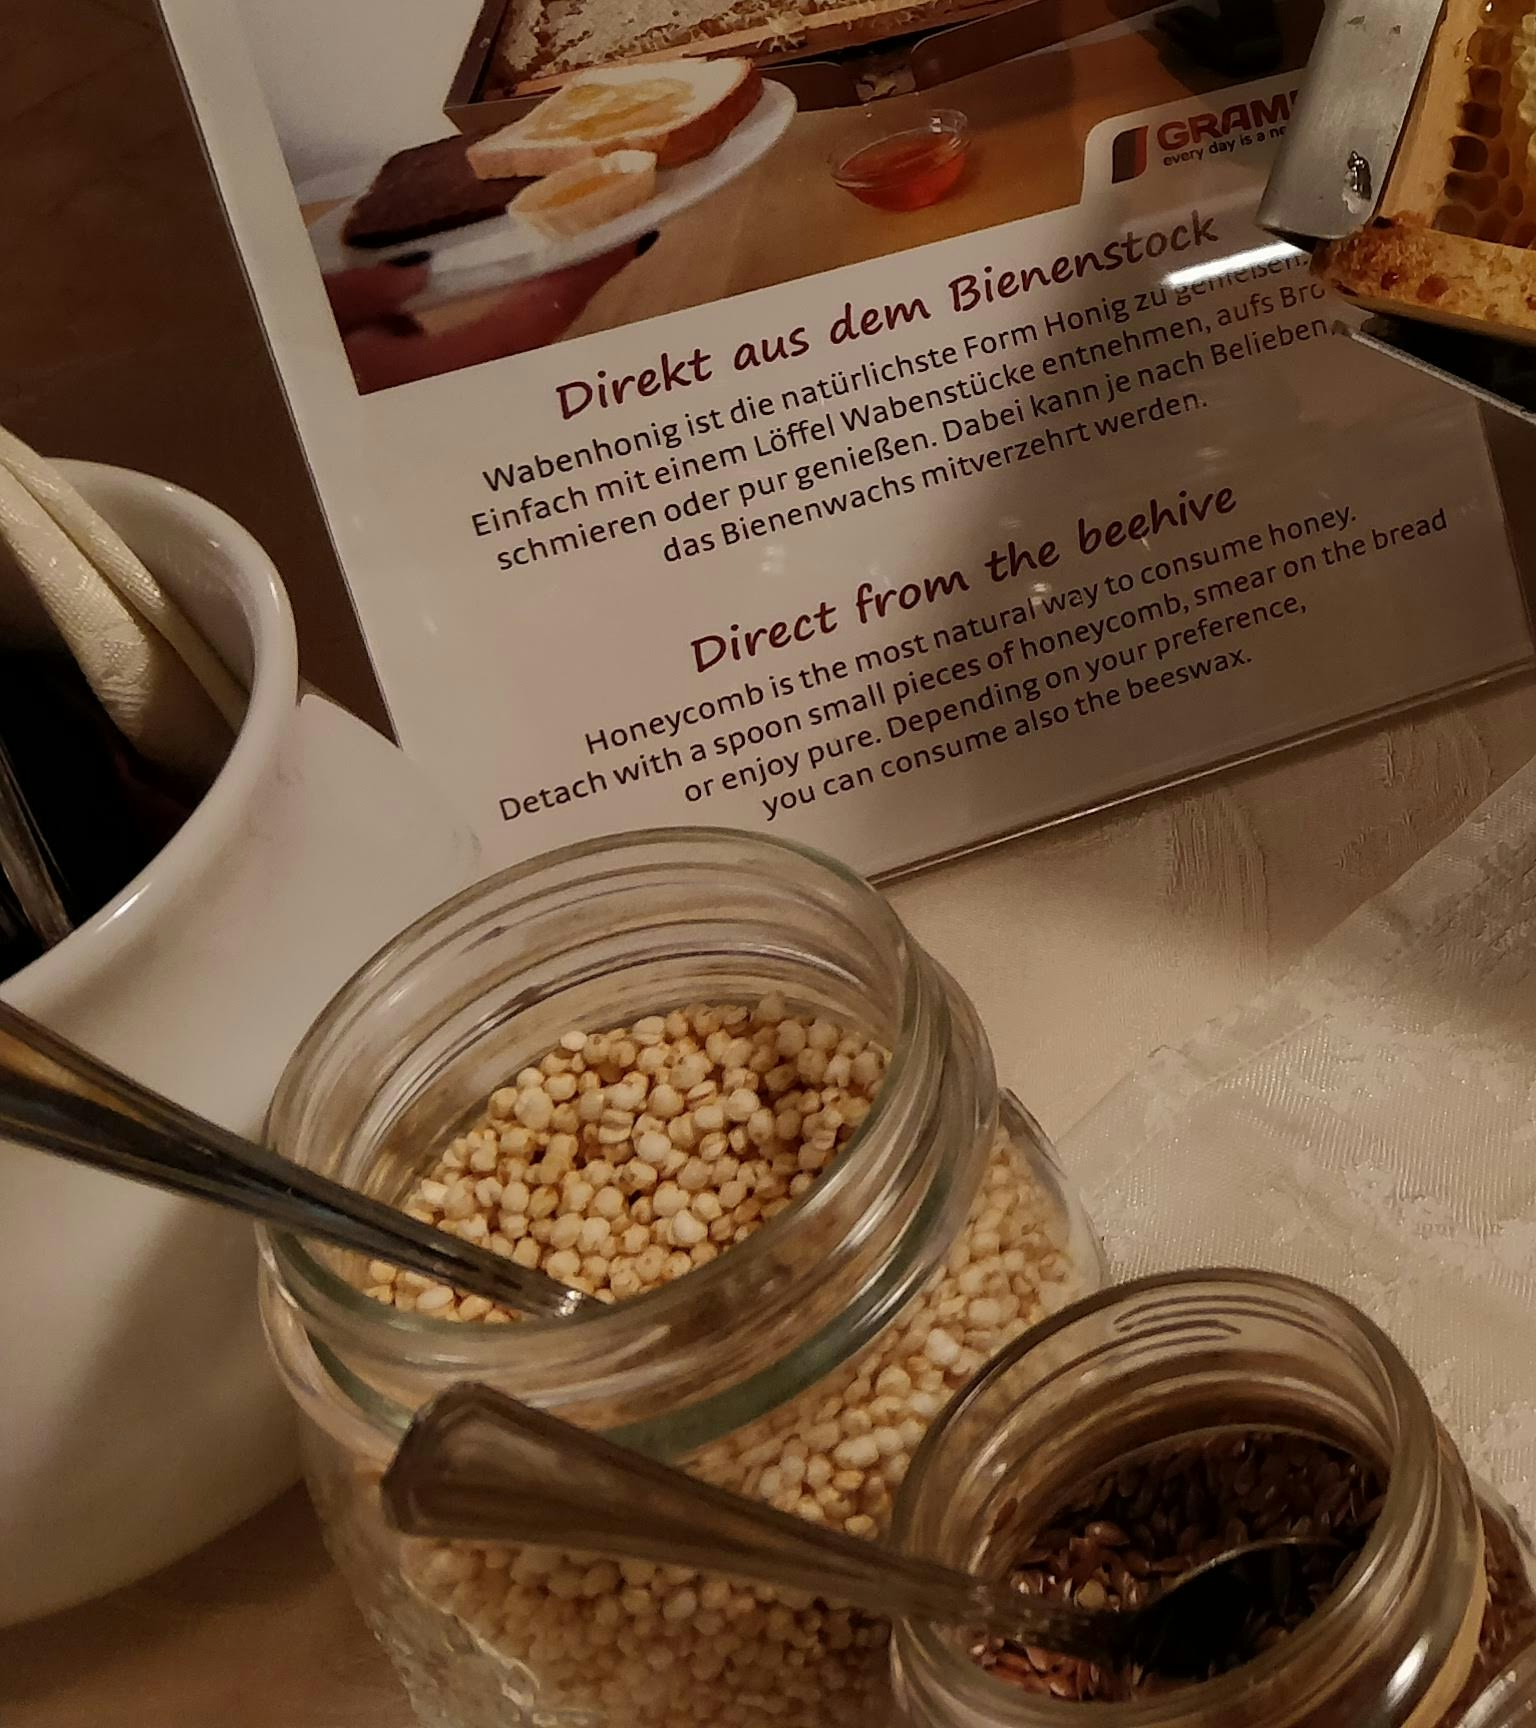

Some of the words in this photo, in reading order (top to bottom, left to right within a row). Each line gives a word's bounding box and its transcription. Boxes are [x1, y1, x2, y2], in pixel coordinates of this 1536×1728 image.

[1157, 89, 1298, 150] GRAM
[1163, 147, 1204, 166] every
[1208, 138, 1236, 154] day
[1240, 133, 1253, 146] is
[1257, 131, 1265, 142] a
[471, 485, 589, 537] Einfach
[594, 469, 651, 502] mit
[654, 445, 748, 485] einem
[753, 412, 836, 457] Löffel
[839, 363, 1036, 432] Wabenstücke
[1042, 316, 1212, 376] entnehmen,
[1215, 292, 1275, 327] aufs
[1278, 283, 1326, 309] Bro
[481, 422, 683, 492] Wabenhonig
[684, 409, 726, 437] ist
[729, 395, 776, 424] die
[780, 346, 959, 411] natürlichste
[962, 324, 1038, 360] Form
[1043, 296, 1131, 337] Honig
[1133, 288, 1168, 313] zu
[555, 348, 713, 421] Direkt
[733, 326, 810, 371] aus
[829, 298, 932, 345] dem
[947, 209, 1220, 313] Bienenstock
[496, 510, 657, 571] schmieren
[663, 487, 731, 523] oder
[737, 471, 789, 508] pur
[794, 432, 938, 491] genießen.
[941, 398, 1025, 443] Dabei
[1029, 384, 1100, 418] kann
[1103, 372, 1132, 404] je
[1136, 349, 1205, 388] nach
[663, 532, 716, 563] das
[720, 474, 916, 546] Bienenwachs
[920, 422, 1092, 489] mitverzehrt
[1092, 392, 1208, 437] werden.
[498, 770, 608, 822] Detach
[612, 747, 683, 785] with
[689, 743, 708, 763] a
[713, 713, 802, 757] spoon
[807, 681, 886, 726] small
[892, 657, 982, 706] pieces
[986, 639, 1015, 671] of
[1018, 592, 1190, 661] honeycomb,
[1193, 565, 1277, 607] smear
[1282, 554, 1317, 579] on
[1320, 538, 1367, 566] the
[1370, 507, 1448, 551] bread
[584, 682, 765, 756] Honeycomb
[768, 675, 795, 699] is
[797, 660, 849, 689] the
[854, 634, 930, 673] most
[932, 597, 1036, 649] natural
[1041, 582, 1099, 615] way
[1103, 573, 1134, 596] to
[1140, 534, 1264, 585] consume
[1267, 505, 1357, 547] honey.
[689, 601, 838, 674] Direct
[855, 570, 971, 625] from
[983, 540, 1061, 583] the
[1077, 487, 1237, 556] beehive
[684, 778, 715, 802] or
[721, 751, 800, 791] enjoy
[807, 729, 882, 770] pure.
[885, 677, 1042, 739] Depending
[1044, 665, 1080, 690] on
[1084, 642, 1148, 683] your
[1153, 596, 1307, 661] preference,
[761, 784, 816, 822] you
[822, 767, 875, 796] can
[880, 725, 1009, 778] consume
[1013, 705, 1070, 737] also
[1073, 688, 1122, 716] the
[1125, 648, 1253, 700] beeswax.
